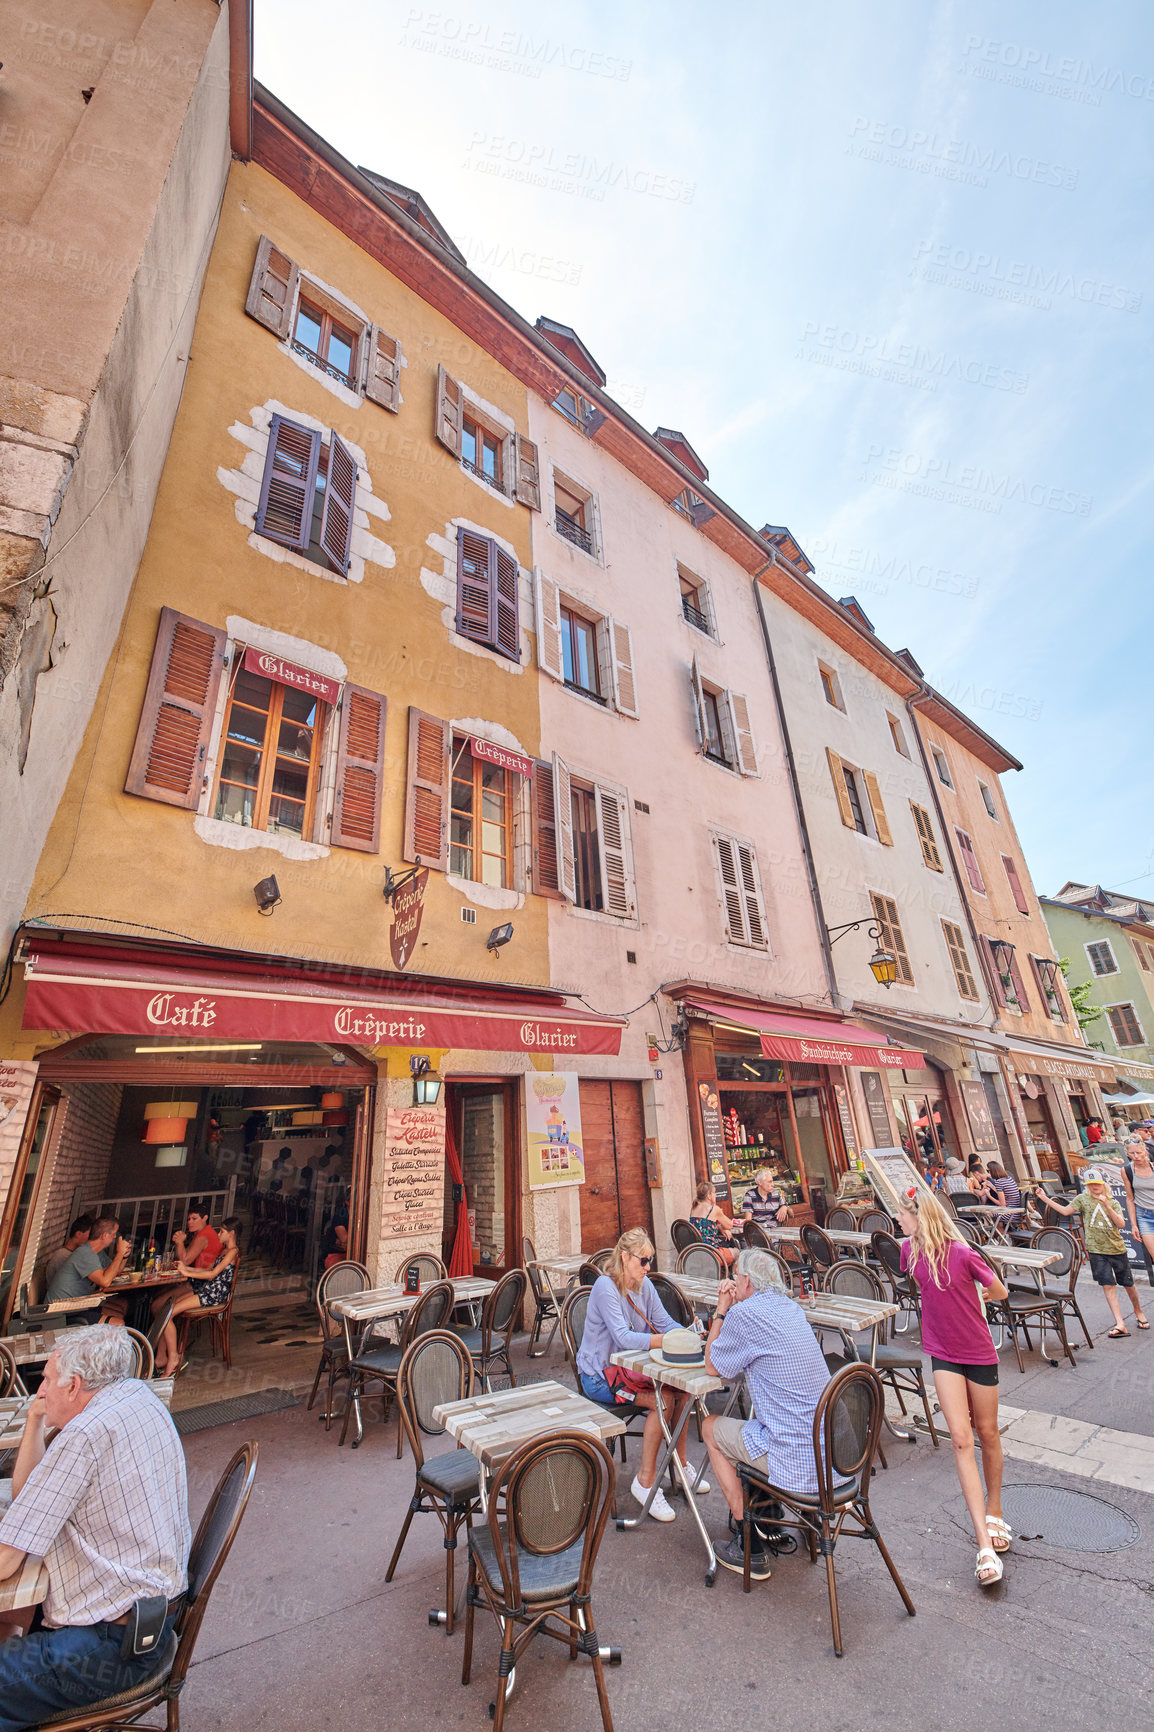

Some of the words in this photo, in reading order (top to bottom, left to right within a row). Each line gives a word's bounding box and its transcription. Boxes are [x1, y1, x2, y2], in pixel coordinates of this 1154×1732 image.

[258, 653, 330, 694] Glacier
[474, 737, 528, 772] Crêperie
[146, 992, 217, 1028] Café
[334, 1006, 426, 1044] Crêperie
[519, 1022, 578, 1048] Glacier
[800, 1040, 853, 1065] Sandwicherie
[401, 1112, 435, 1126] Crêperie
[394, 1126, 438, 1145] Kastell
[389, 1147, 413, 1156] Salades
[394, 1190, 413, 1200] Crêpes
[405, 1200, 424, 1211] Glaces
[391, 1224, 407, 1233] Salle
